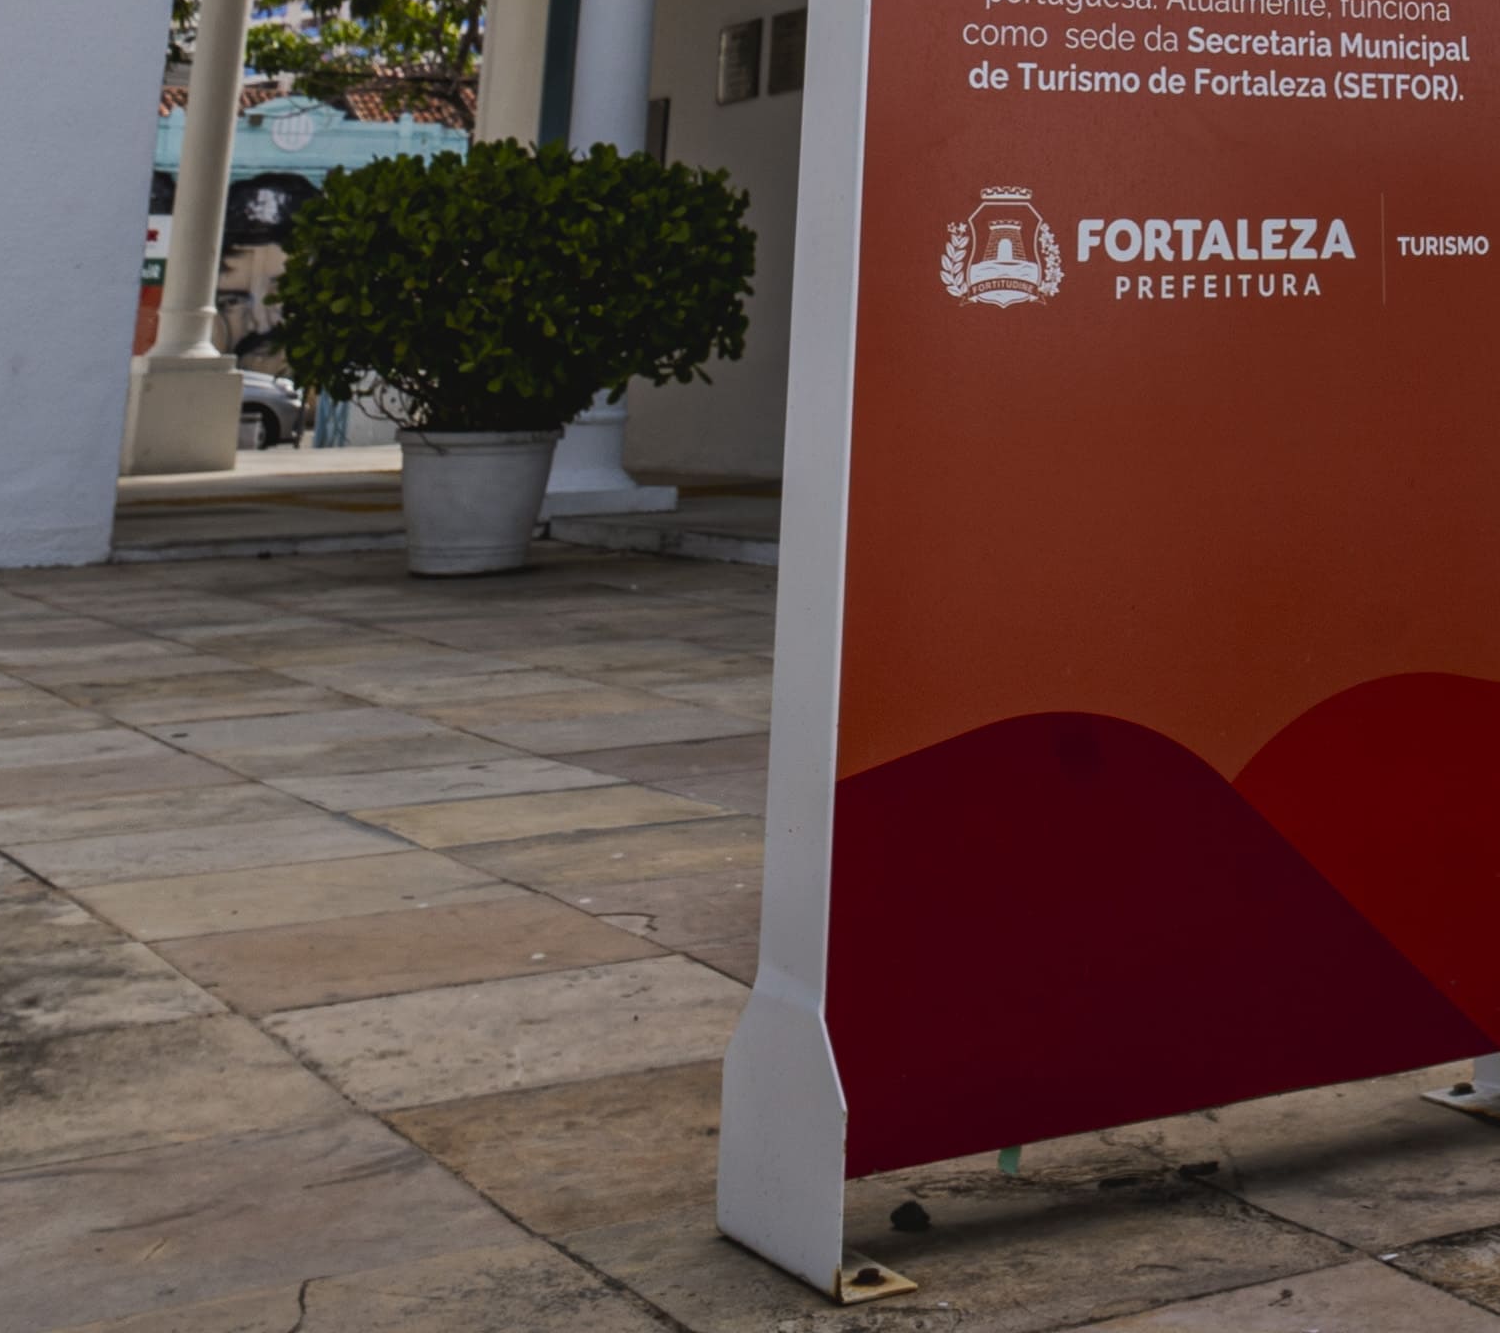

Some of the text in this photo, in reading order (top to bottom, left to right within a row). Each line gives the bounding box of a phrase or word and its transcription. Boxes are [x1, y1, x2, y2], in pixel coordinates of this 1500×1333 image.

[962, 22, 1471, 68] como sede da Secretaria Municipal
[968, 60, 1465, 102] de Turismo de Fortaleza (SETFOR).
[1077, 218, 1489, 263] FORTALEZA TURISMO
[1115, 272, 1322, 301] PREFEITURA
